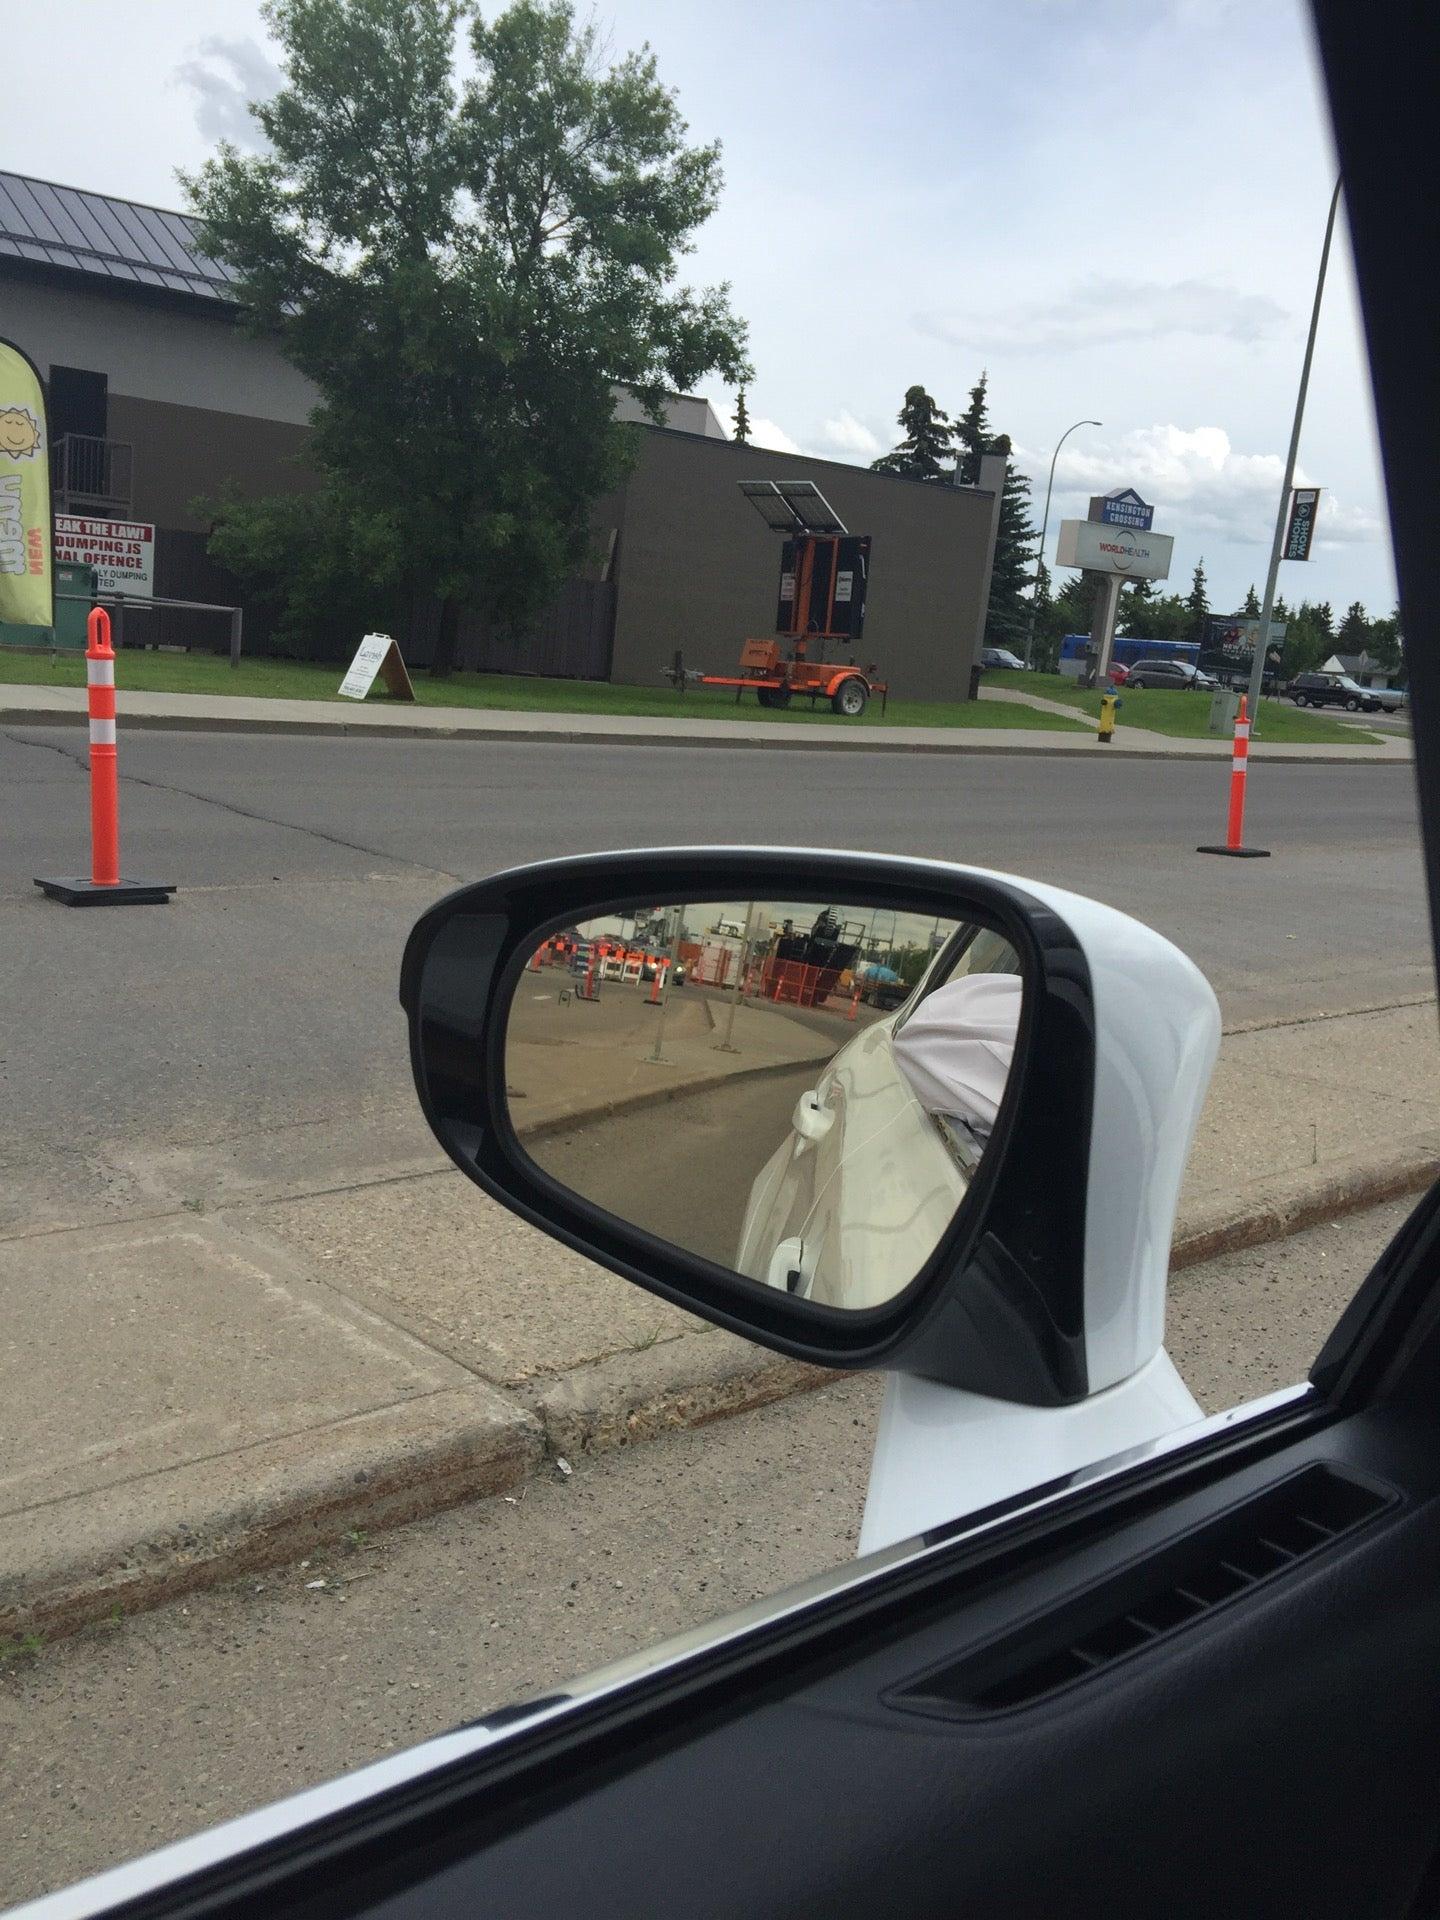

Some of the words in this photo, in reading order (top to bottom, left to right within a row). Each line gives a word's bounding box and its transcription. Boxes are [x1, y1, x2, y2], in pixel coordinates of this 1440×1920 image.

[1106, 501, 1151, 517] KENSINGTON
[55, 518, 81, 534] EAK
[85, 521, 109, 536] THE
[112, 524, 145, 540] LAW!
[1110, 512, 1145, 527] CROSSING
[55, 535, 124, 553] DUMPING
[127, 543, 142, 555] IS
[1289, 518, 1302, 557] HOMES
[1297, 520, 1310, 556] SHOW
[54, 549, 79, 562] NAL
[83, 552, 143, 569] OFFENCE
[98, 570, 108, 578] LY
[110, 570, 148, 581] DUMPING
[99, 579, 115, 588] TED
